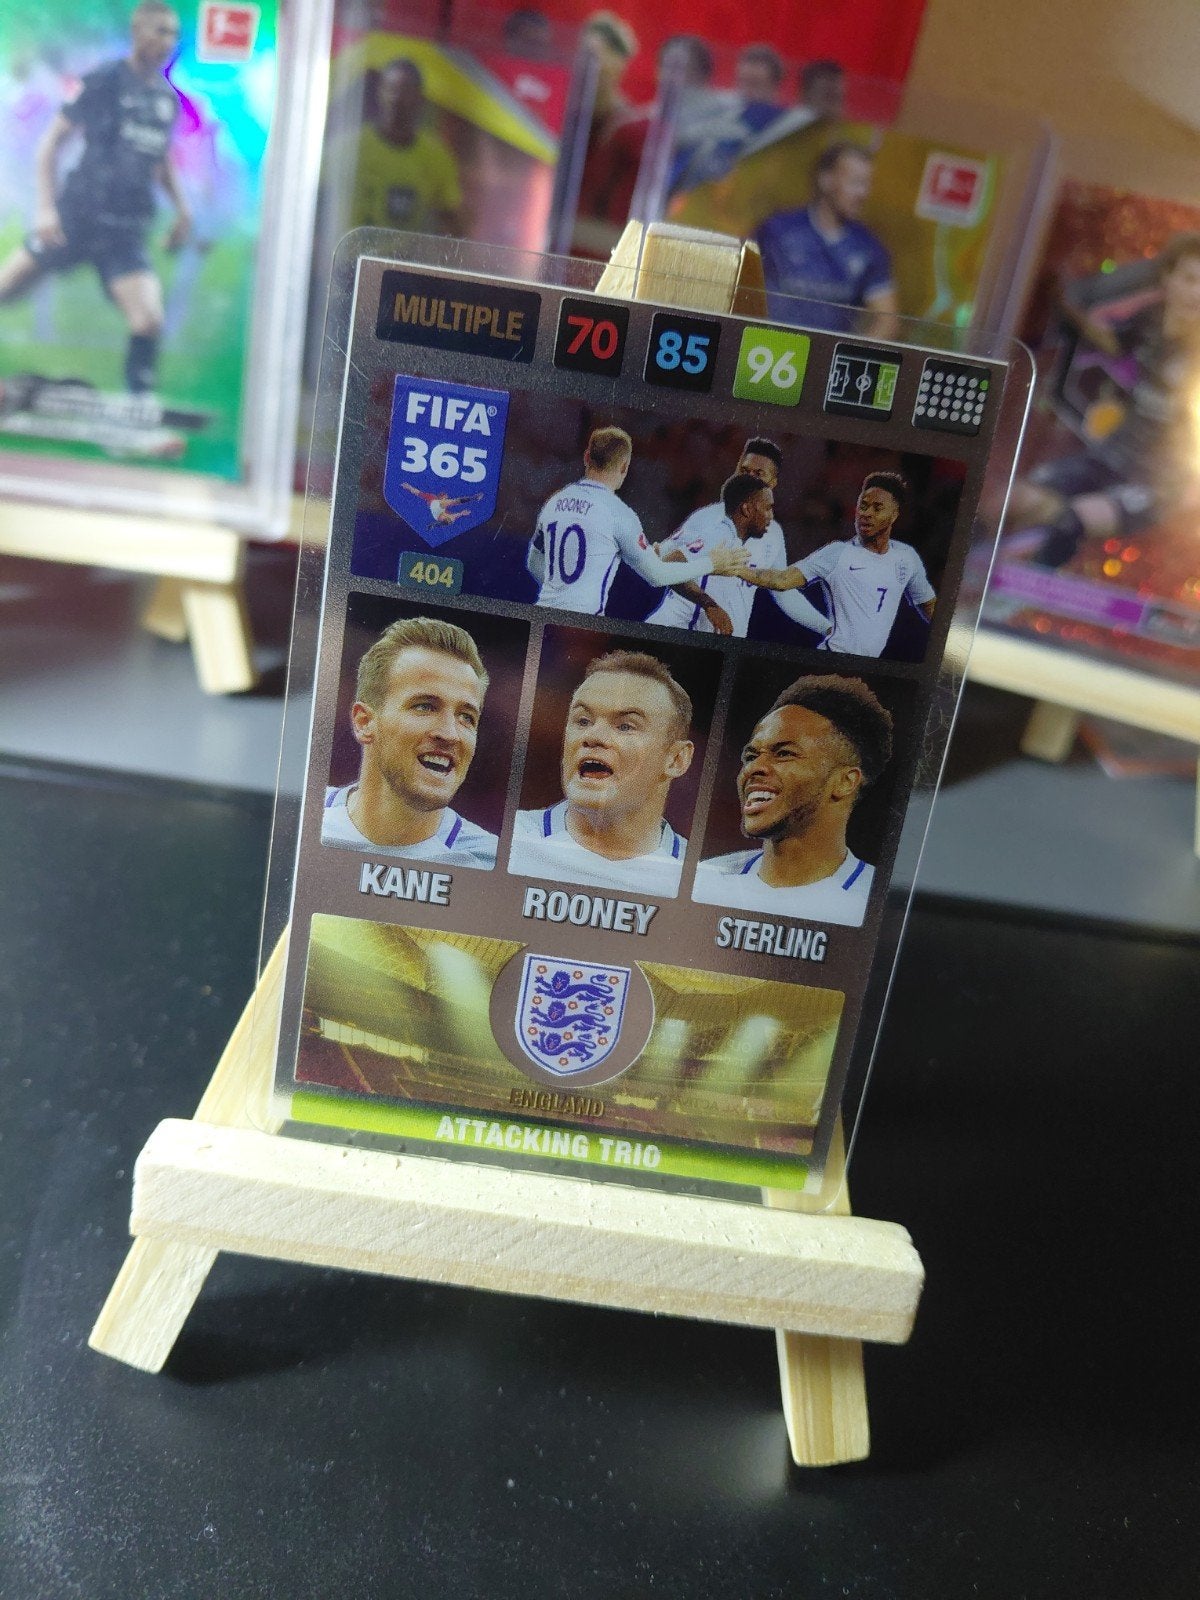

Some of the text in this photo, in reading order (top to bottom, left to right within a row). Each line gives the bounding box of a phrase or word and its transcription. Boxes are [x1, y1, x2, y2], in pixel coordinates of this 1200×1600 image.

[393, 293, 524, 341] MULTIPLE
[567, 316, 619, 360] 70
[655, 330, 710, 374] 85
[747, 345, 798, 388] 96
[401, 437, 488, 483] 365
[555, 497, 593, 515] ROONEY
[409, 561, 454, 588] 404
[547, 521, 587, 585] 10
[877, 587, 888, 612] 7
[359, 862, 452, 906] KANE
[522, 886, 658, 935] ROONEY
[715, 915, 828, 963] STERLING
[509, 1087, 606, 1118] ENGLAND
[436, 1115, 662, 1169] ATTACKING TRIO
